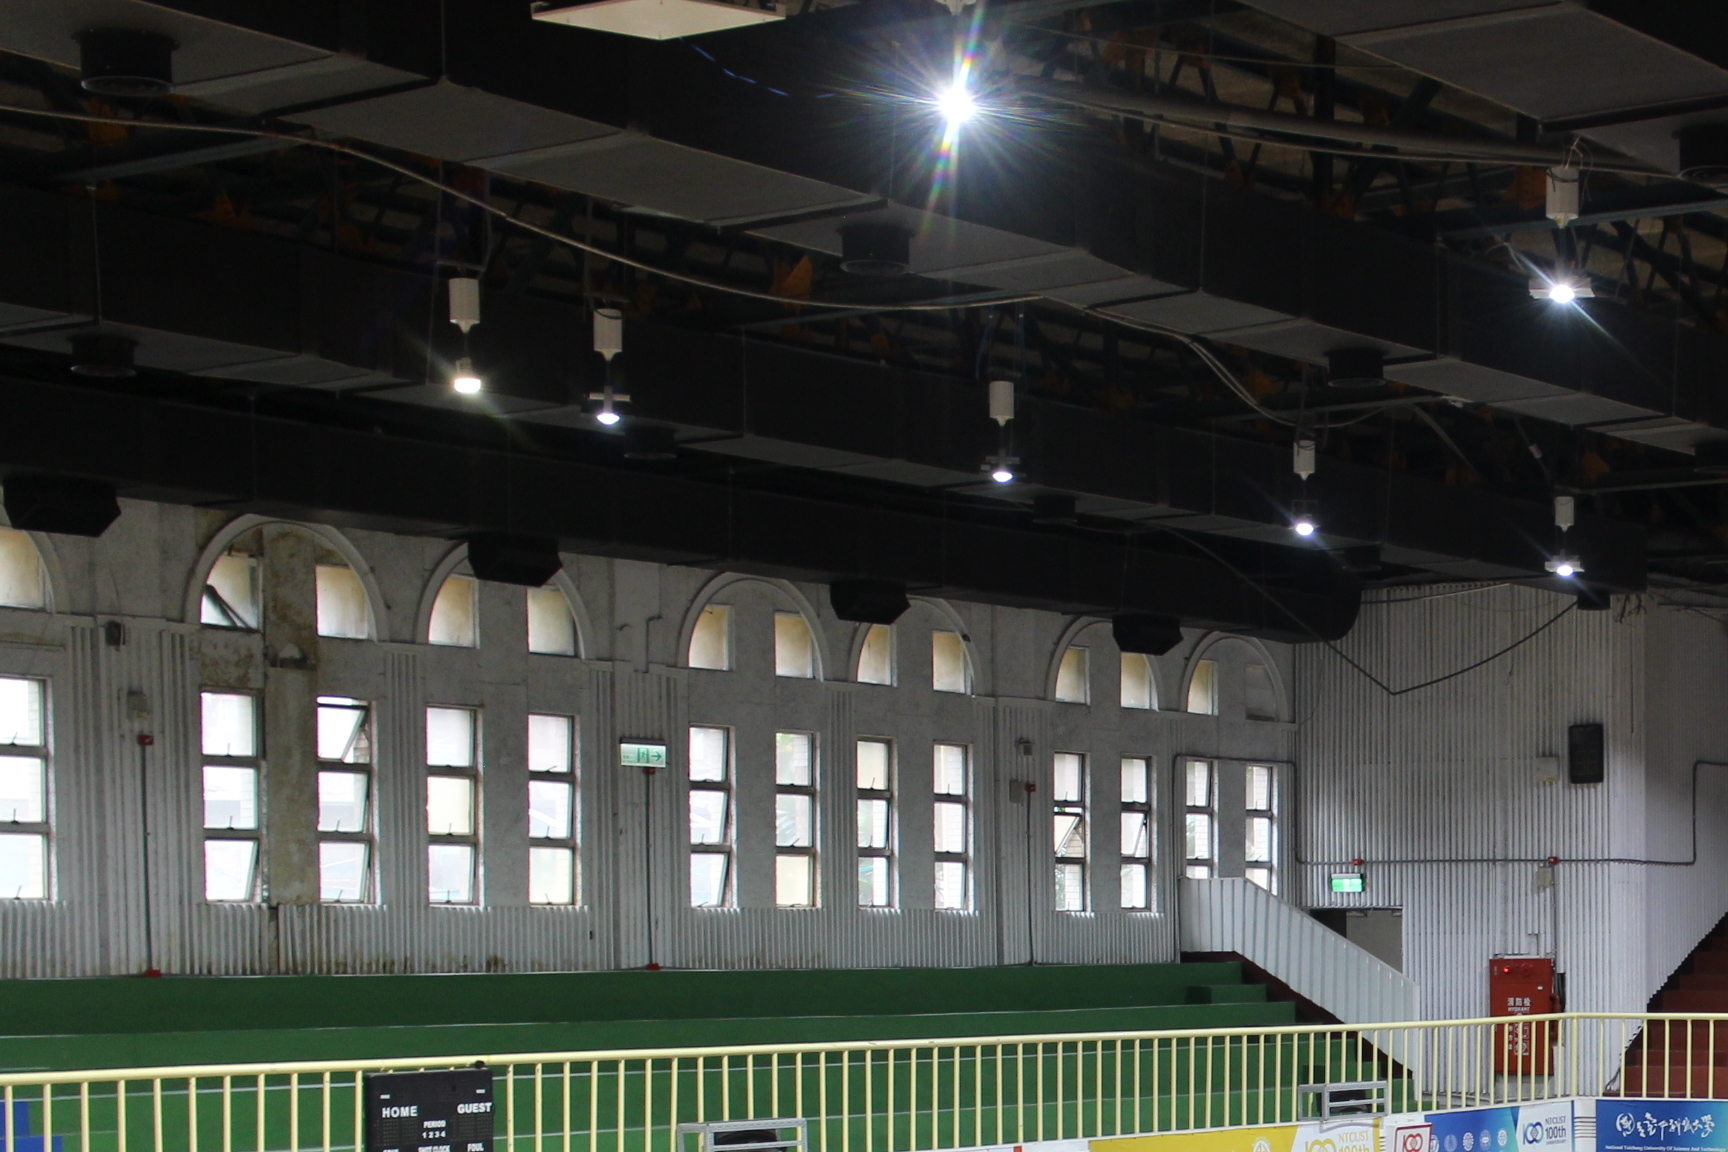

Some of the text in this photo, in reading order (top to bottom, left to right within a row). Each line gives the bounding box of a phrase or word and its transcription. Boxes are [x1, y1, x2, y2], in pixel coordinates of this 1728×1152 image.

[1507, 997, 1531, 1007] 消防栓
[382, 1105, 418, 1118] HOME
[457, 1102, 492, 1114] GUEST
[423, 1120, 446, 1128] PERIOD
[1545, 1116, 1566, 1124] NTCUST
[1339, 1131, 1369, 1145] NTCUST
[1545, 1126, 1567, 1141] 100th
[467, 1143, 484, 1152] FOUL
